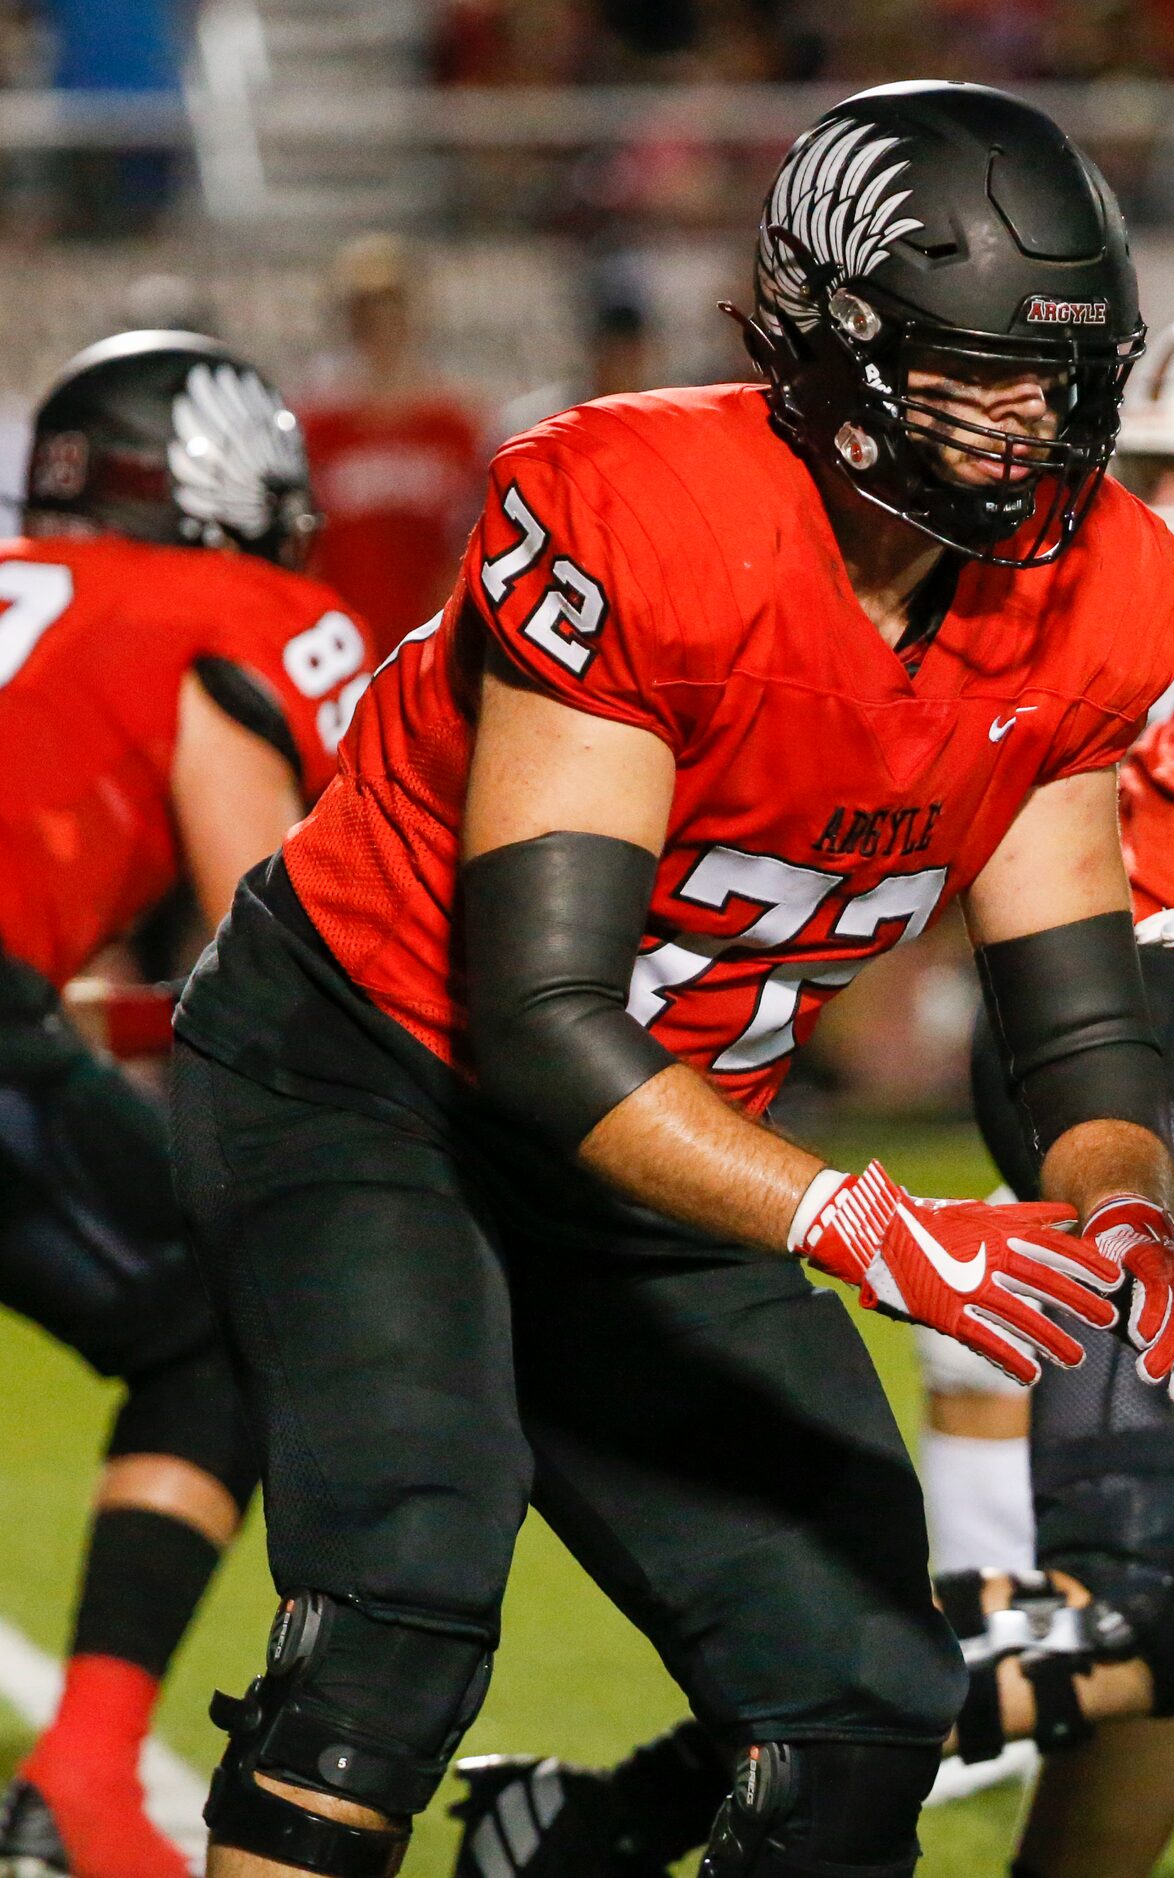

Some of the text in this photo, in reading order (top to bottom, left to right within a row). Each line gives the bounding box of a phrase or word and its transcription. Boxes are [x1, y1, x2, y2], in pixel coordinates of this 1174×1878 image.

[1026, 300, 1106, 324] ARGYLE
[479, 481, 609, 679] 72
[811, 801, 944, 858] ARGYLE
[337, 1757, 348, 1770] 5
